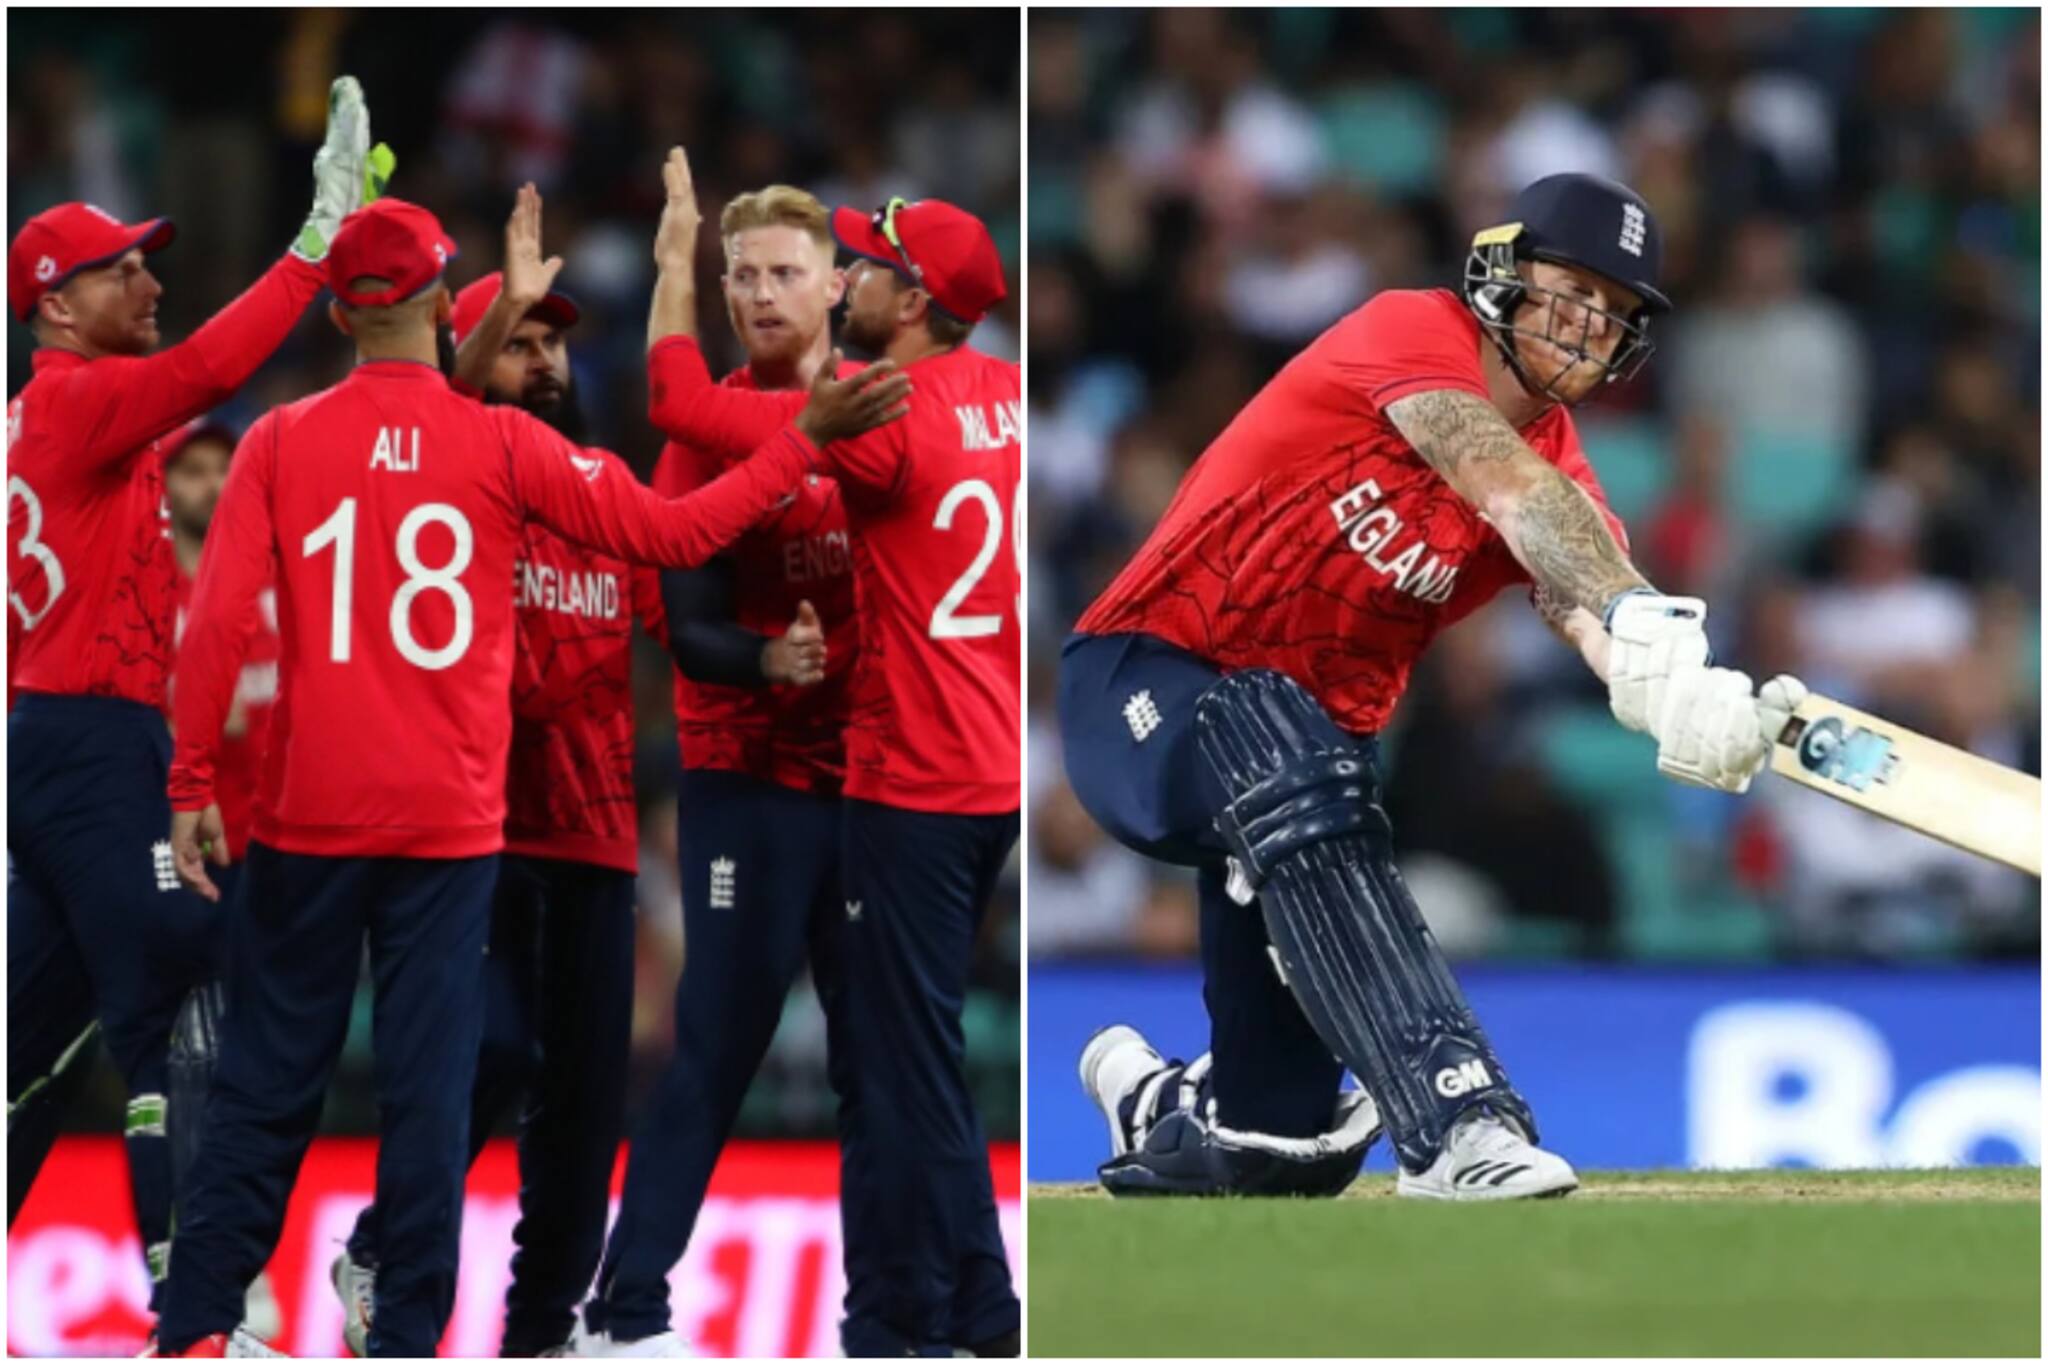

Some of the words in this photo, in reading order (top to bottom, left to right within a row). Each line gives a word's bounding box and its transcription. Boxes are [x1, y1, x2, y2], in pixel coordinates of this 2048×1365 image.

[370, 426, 420, 472] ALI
[302, 496, 474, 670] 18
[928, 477, 1021, 640] 2
[1435, 1058, 1493, 1098] GM
